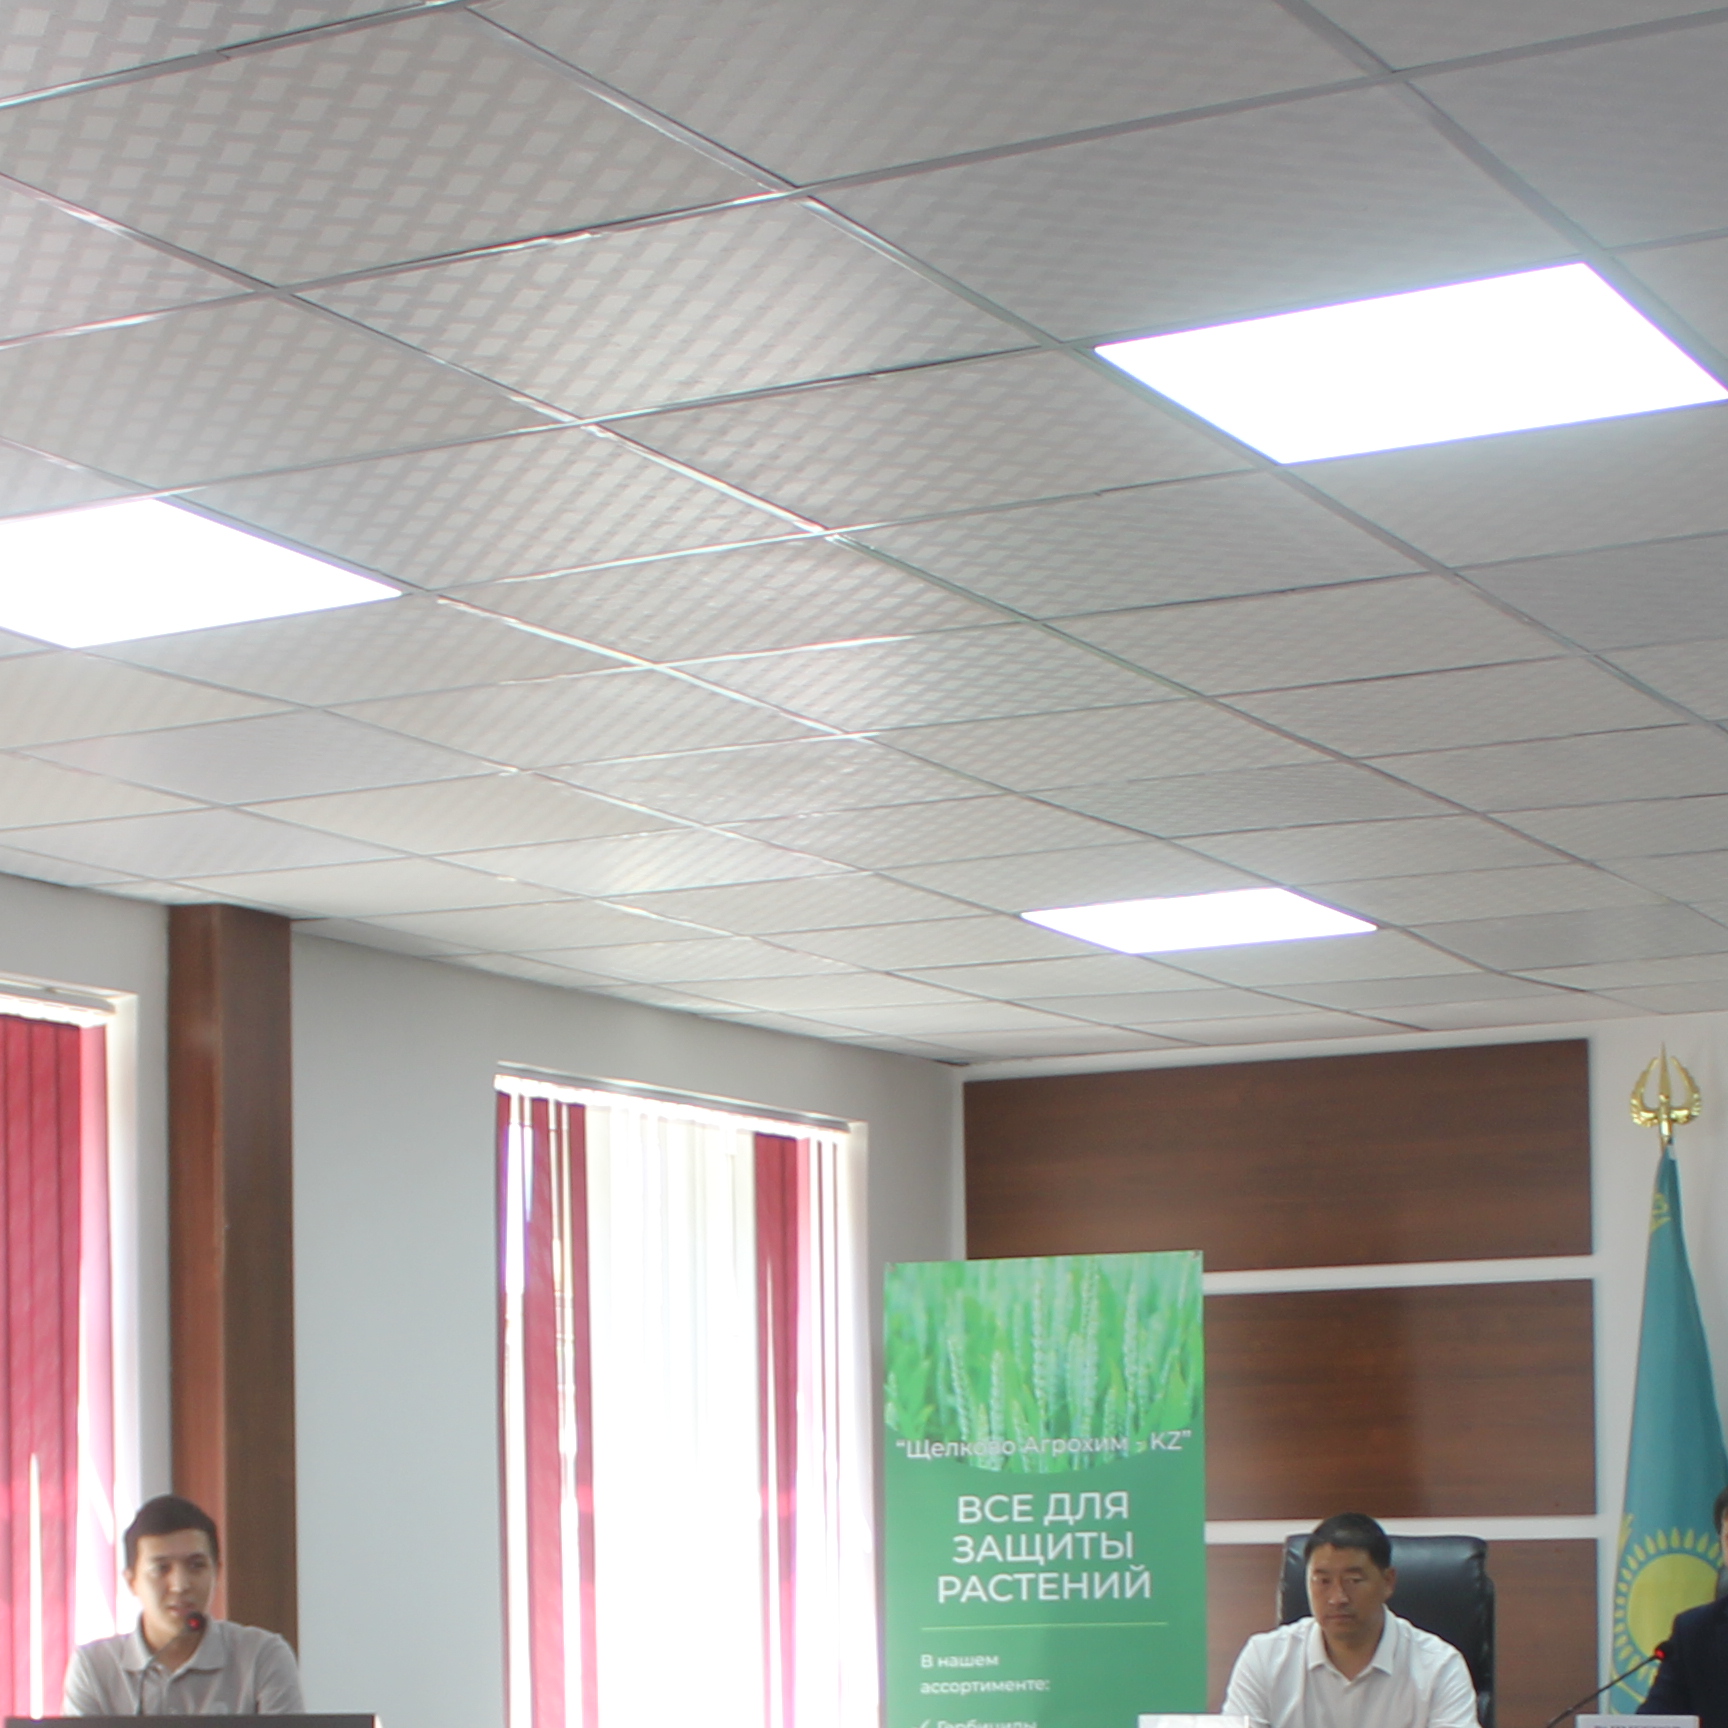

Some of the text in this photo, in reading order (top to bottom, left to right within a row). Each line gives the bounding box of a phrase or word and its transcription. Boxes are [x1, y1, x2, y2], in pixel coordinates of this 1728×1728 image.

[1022, 1436, 1128, 1457] Агрохим
[958, 1491, 1129, 1526] ВСЕ ДЛЯ
[952, 1531, 1133, 1566] ЗАЩИТЫ
[938, 1564, 1151, 1603] РАСТЕНИЙ
[921, 1654, 1000, 1668] В нашем
[920, 1679, 1051, 1696] ассортименте:
